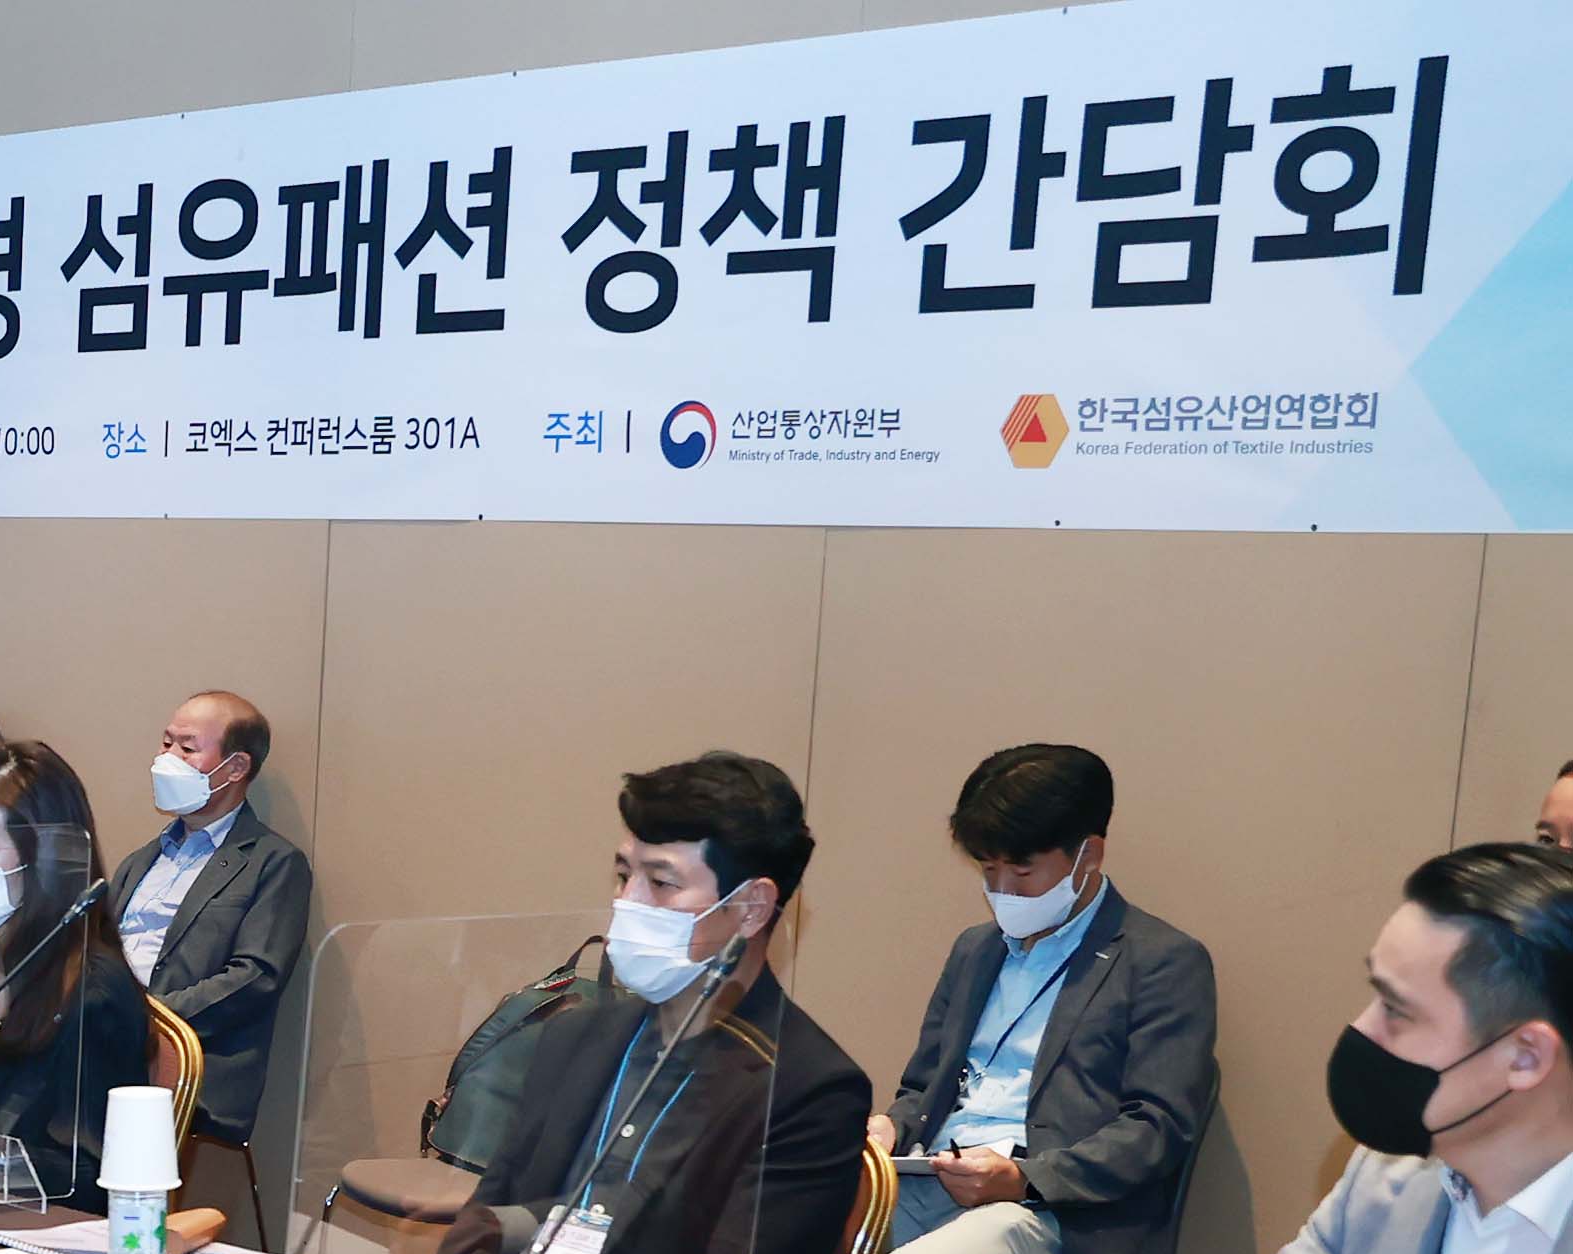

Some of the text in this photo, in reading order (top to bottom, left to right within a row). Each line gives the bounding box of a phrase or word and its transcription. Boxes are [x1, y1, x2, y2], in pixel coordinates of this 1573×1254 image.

[60, 145, 515, 355] 섬유패션
[560, 114, 846, 335] 정책
[898, 54, 1449, 316] 간담회
[730, 407, 902, 441] 산업통상자원부
[1076, 391, 1380, 433] 한국섬유산업연합회
[102, 421, 148, 459] 장소
[185, 418, 258, 457] 코엑스
[266, 415, 396, 457] 컨퍼런스룸
[404, 416, 481, 450] 301A
[542, 410, 604, 454] 주최
[1075, 438, 1373, 456] Korea Federation of Textile Industries
[729, 449, 941, 464] Ministry of Trade, Industry and Energy
